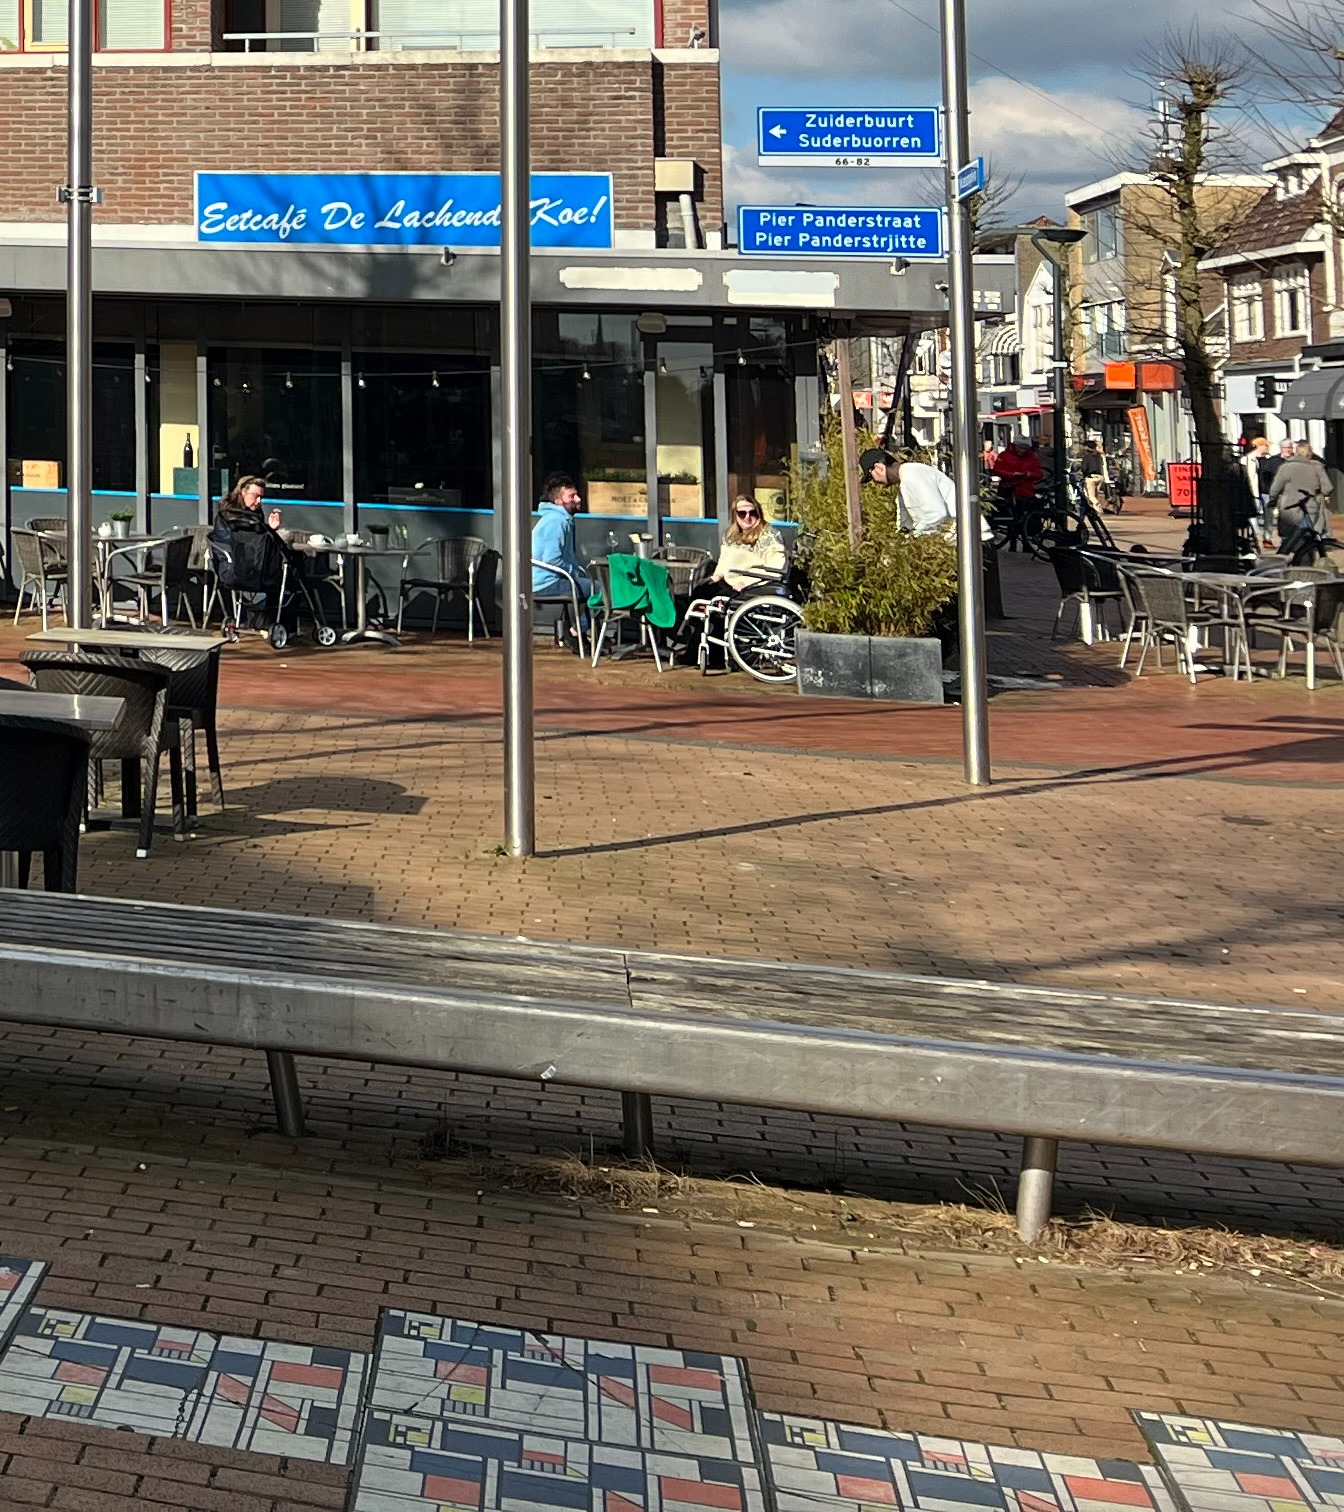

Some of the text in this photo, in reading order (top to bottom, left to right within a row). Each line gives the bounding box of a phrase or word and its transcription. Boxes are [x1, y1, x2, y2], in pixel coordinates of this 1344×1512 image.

[805, 114, 914, 128] Zuiderbuurt
[799, 134, 922, 148] Suderbuorren
[835, 158, 870, 166] 66-82
[200, 196, 607, 239] Eetcafé De Lachend Koe!
[759, 212, 922, 229] Pier Panderstraat
[756, 232, 927, 252] Pier Panderstrjitte
